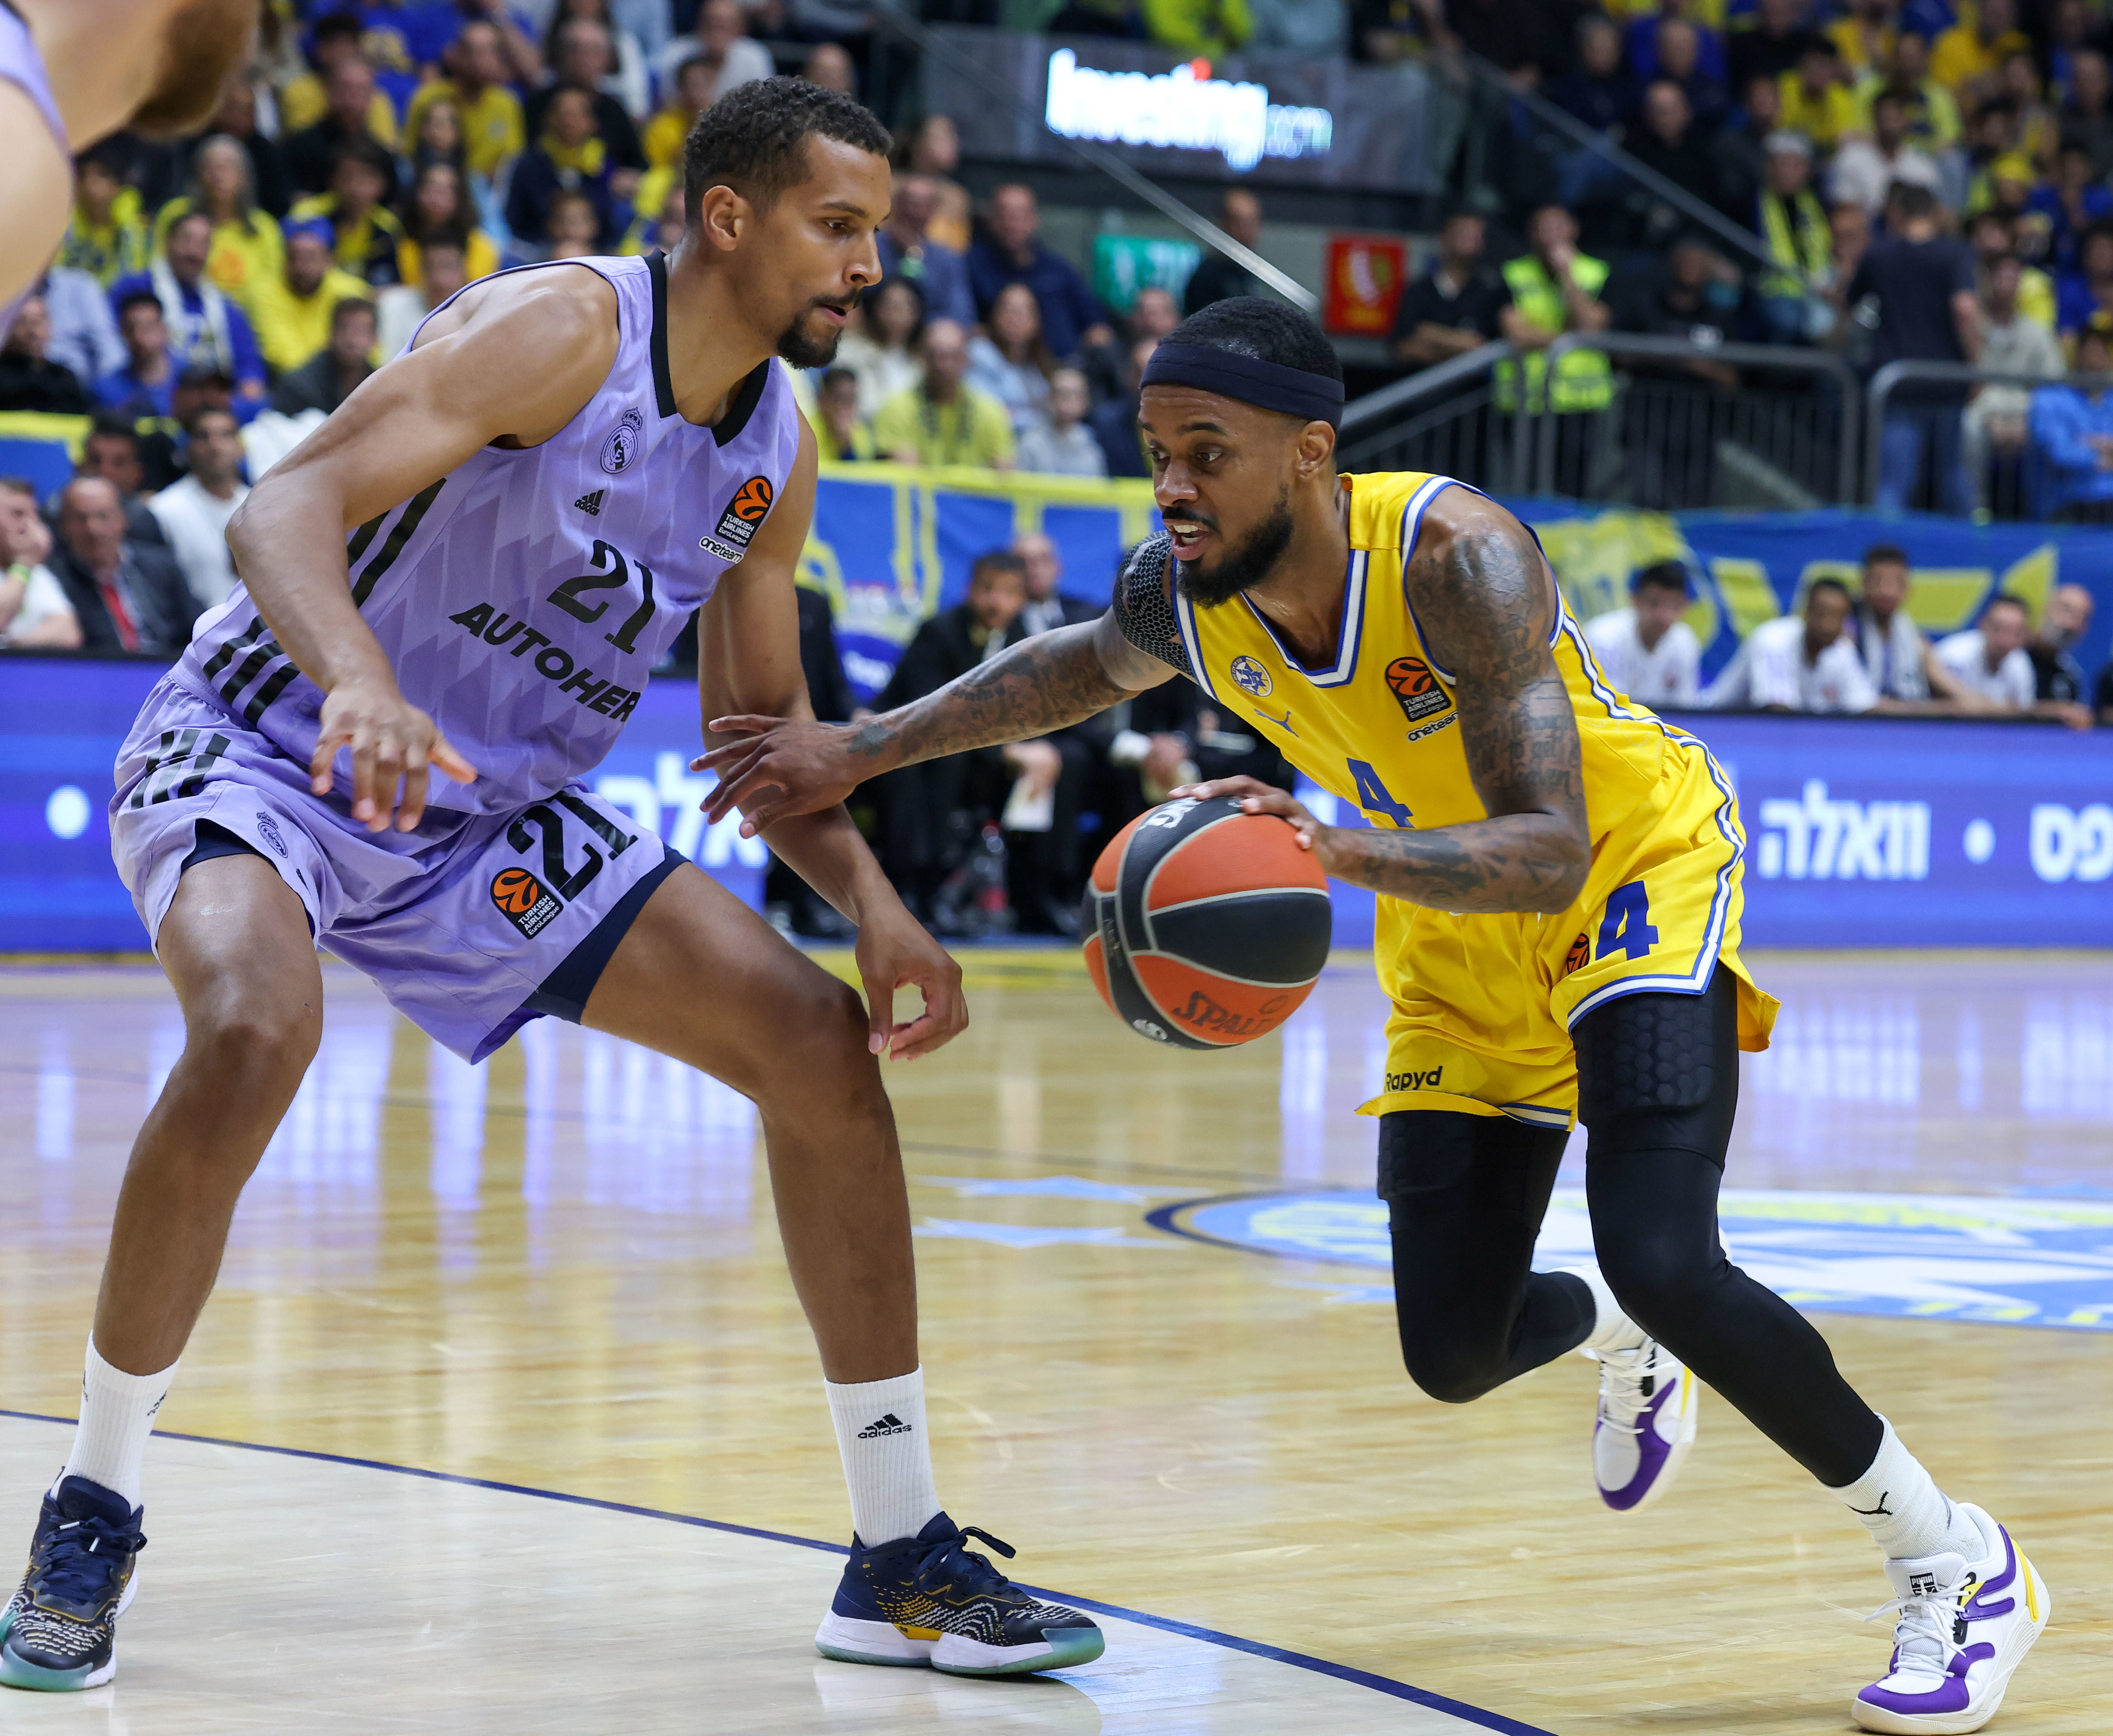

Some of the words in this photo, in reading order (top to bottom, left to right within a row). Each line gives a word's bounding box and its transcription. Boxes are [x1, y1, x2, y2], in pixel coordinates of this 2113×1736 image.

[574, 499, 600, 516] adidas
[718, 527, 747, 545] EuroLeague
[722, 521, 751, 539] AIRLINES
[726, 514, 755, 532] TURKISH
[700, 537, 743, 563] oneteam
[546, 539, 656, 654] 21
[448, 602, 641, 722] AUTOHER
[1403, 690, 1442, 706] TURKISH
[1408, 695, 1444, 713] AIRLINES
[1347, 757, 1415, 828] 4
[1758, 778, 1931, 880] וואלה
[2030, 803, 2113, 883] פס
[507, 790, 639, 902] 21
[518, 895, 551, 925] TURKISH
[523, 900, 555, 931] AIRLINES
[527, 905, 560, 936] EuroLeague
[1595, 880, 1658, 961] 4
[858, 1424, 912, 1439] adidas
[1911, 1575, 1933, 1585] PUMA
